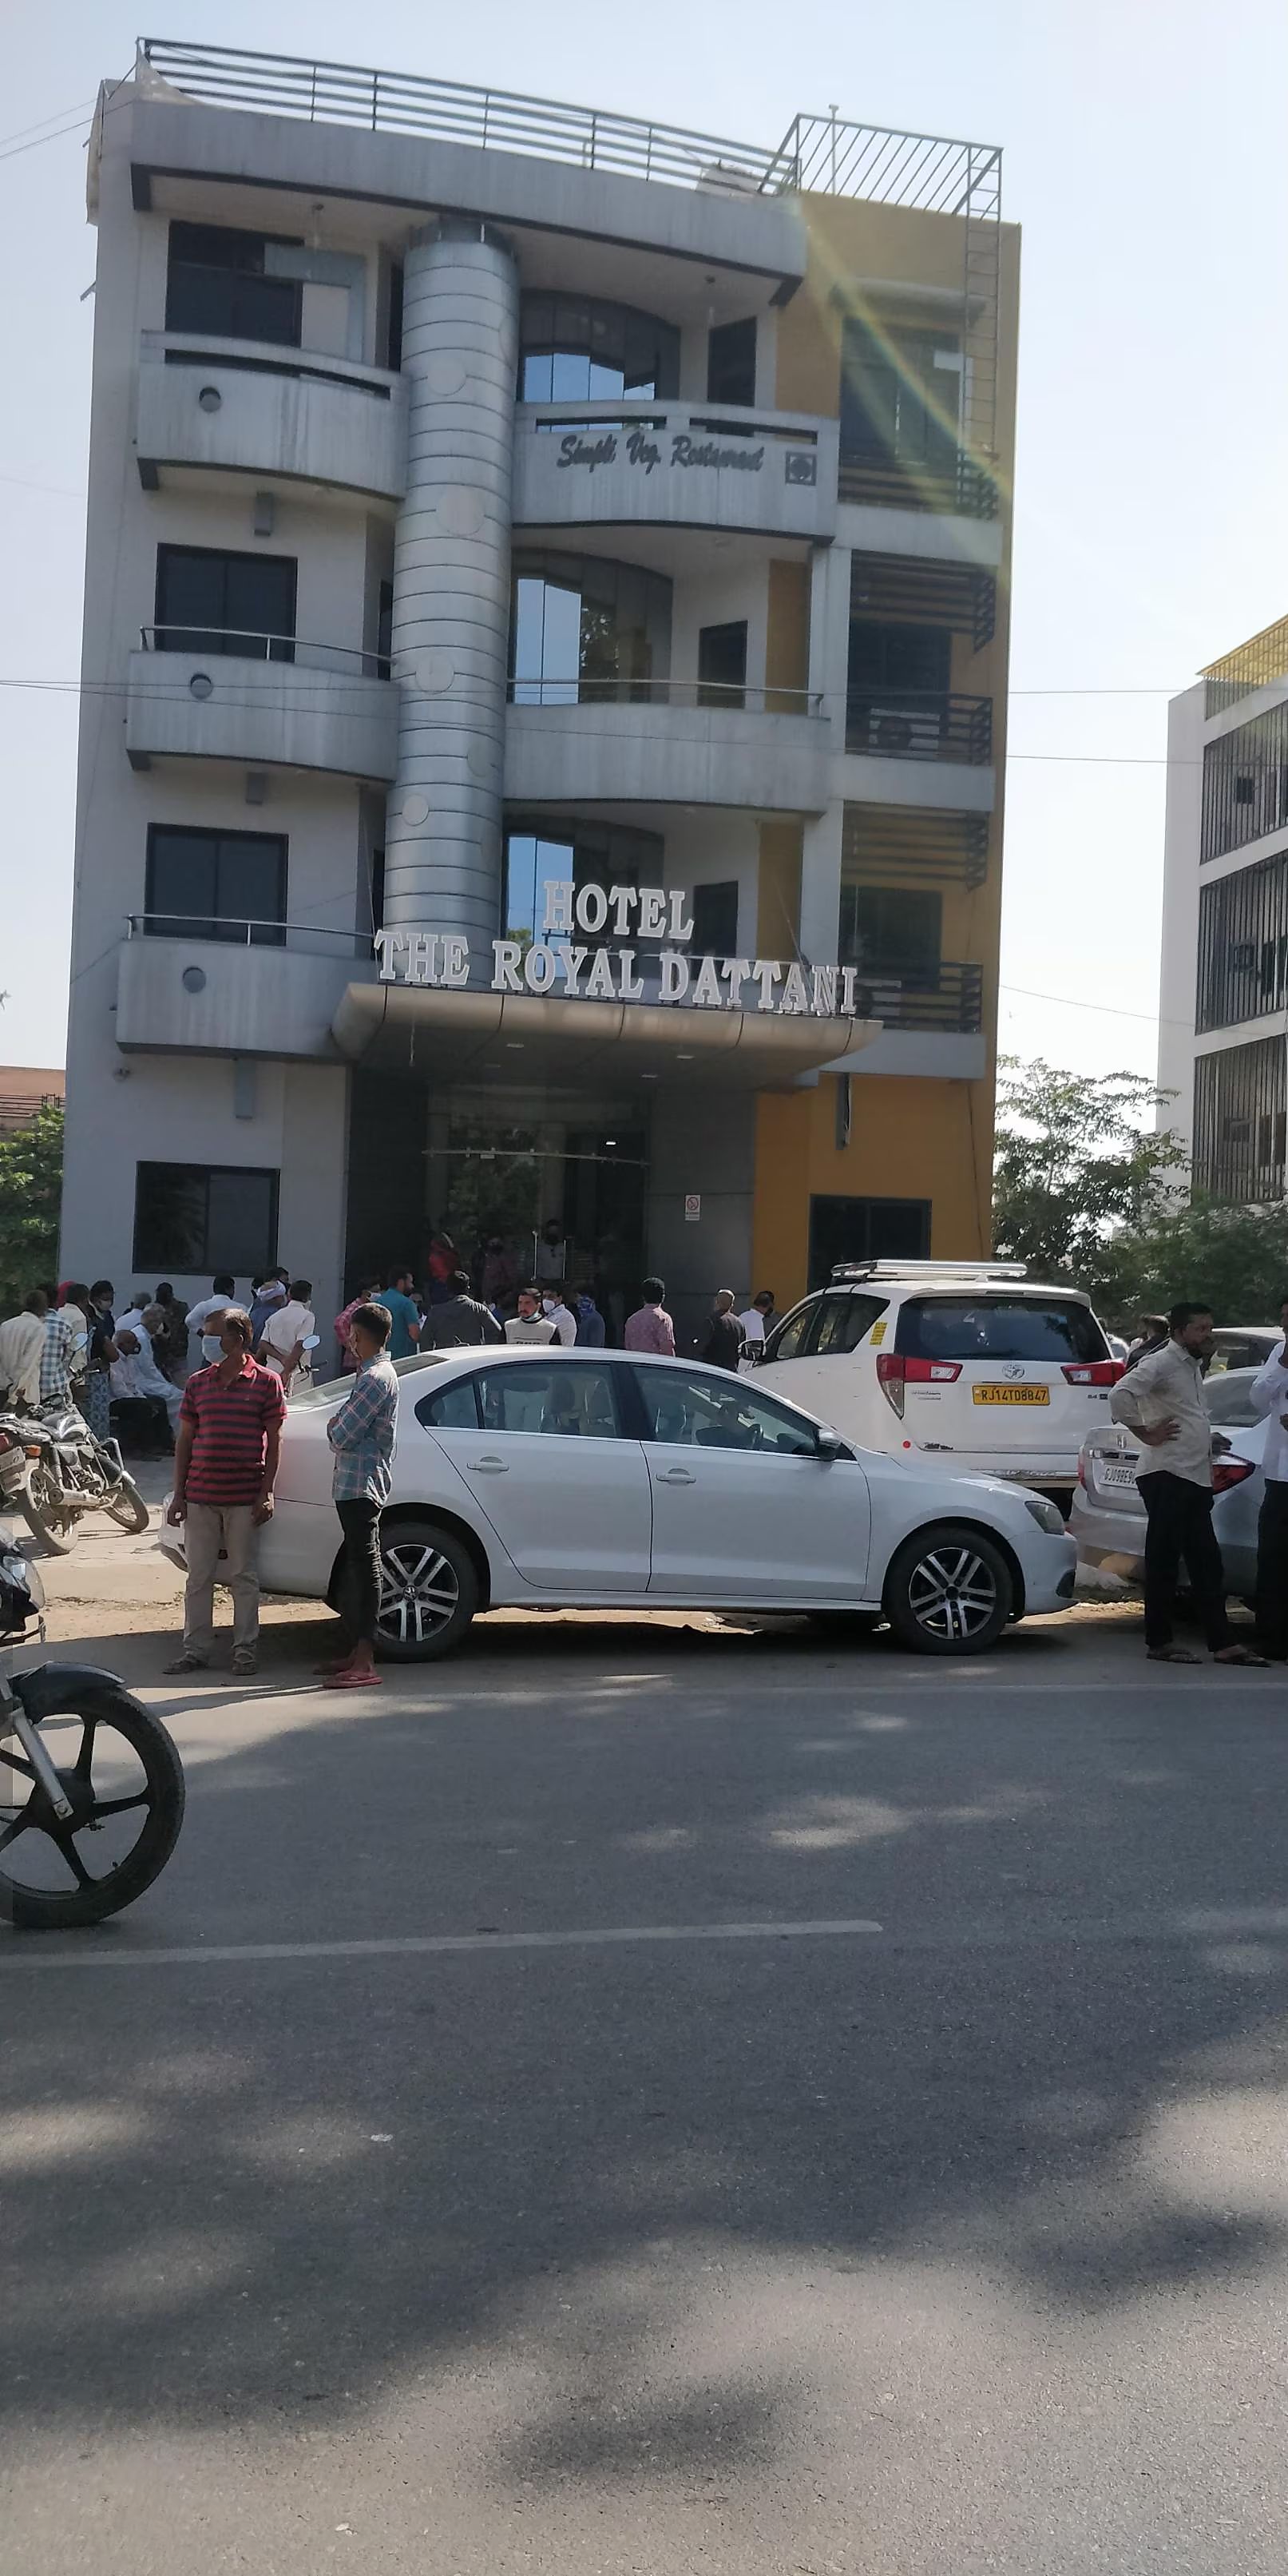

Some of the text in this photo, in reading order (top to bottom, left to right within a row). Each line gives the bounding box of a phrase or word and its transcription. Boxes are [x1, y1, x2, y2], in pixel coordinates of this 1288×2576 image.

[543, 881, 695, 940] HOTEL
[374, 929, 858, 1016] THE ROYAL DATTANI
